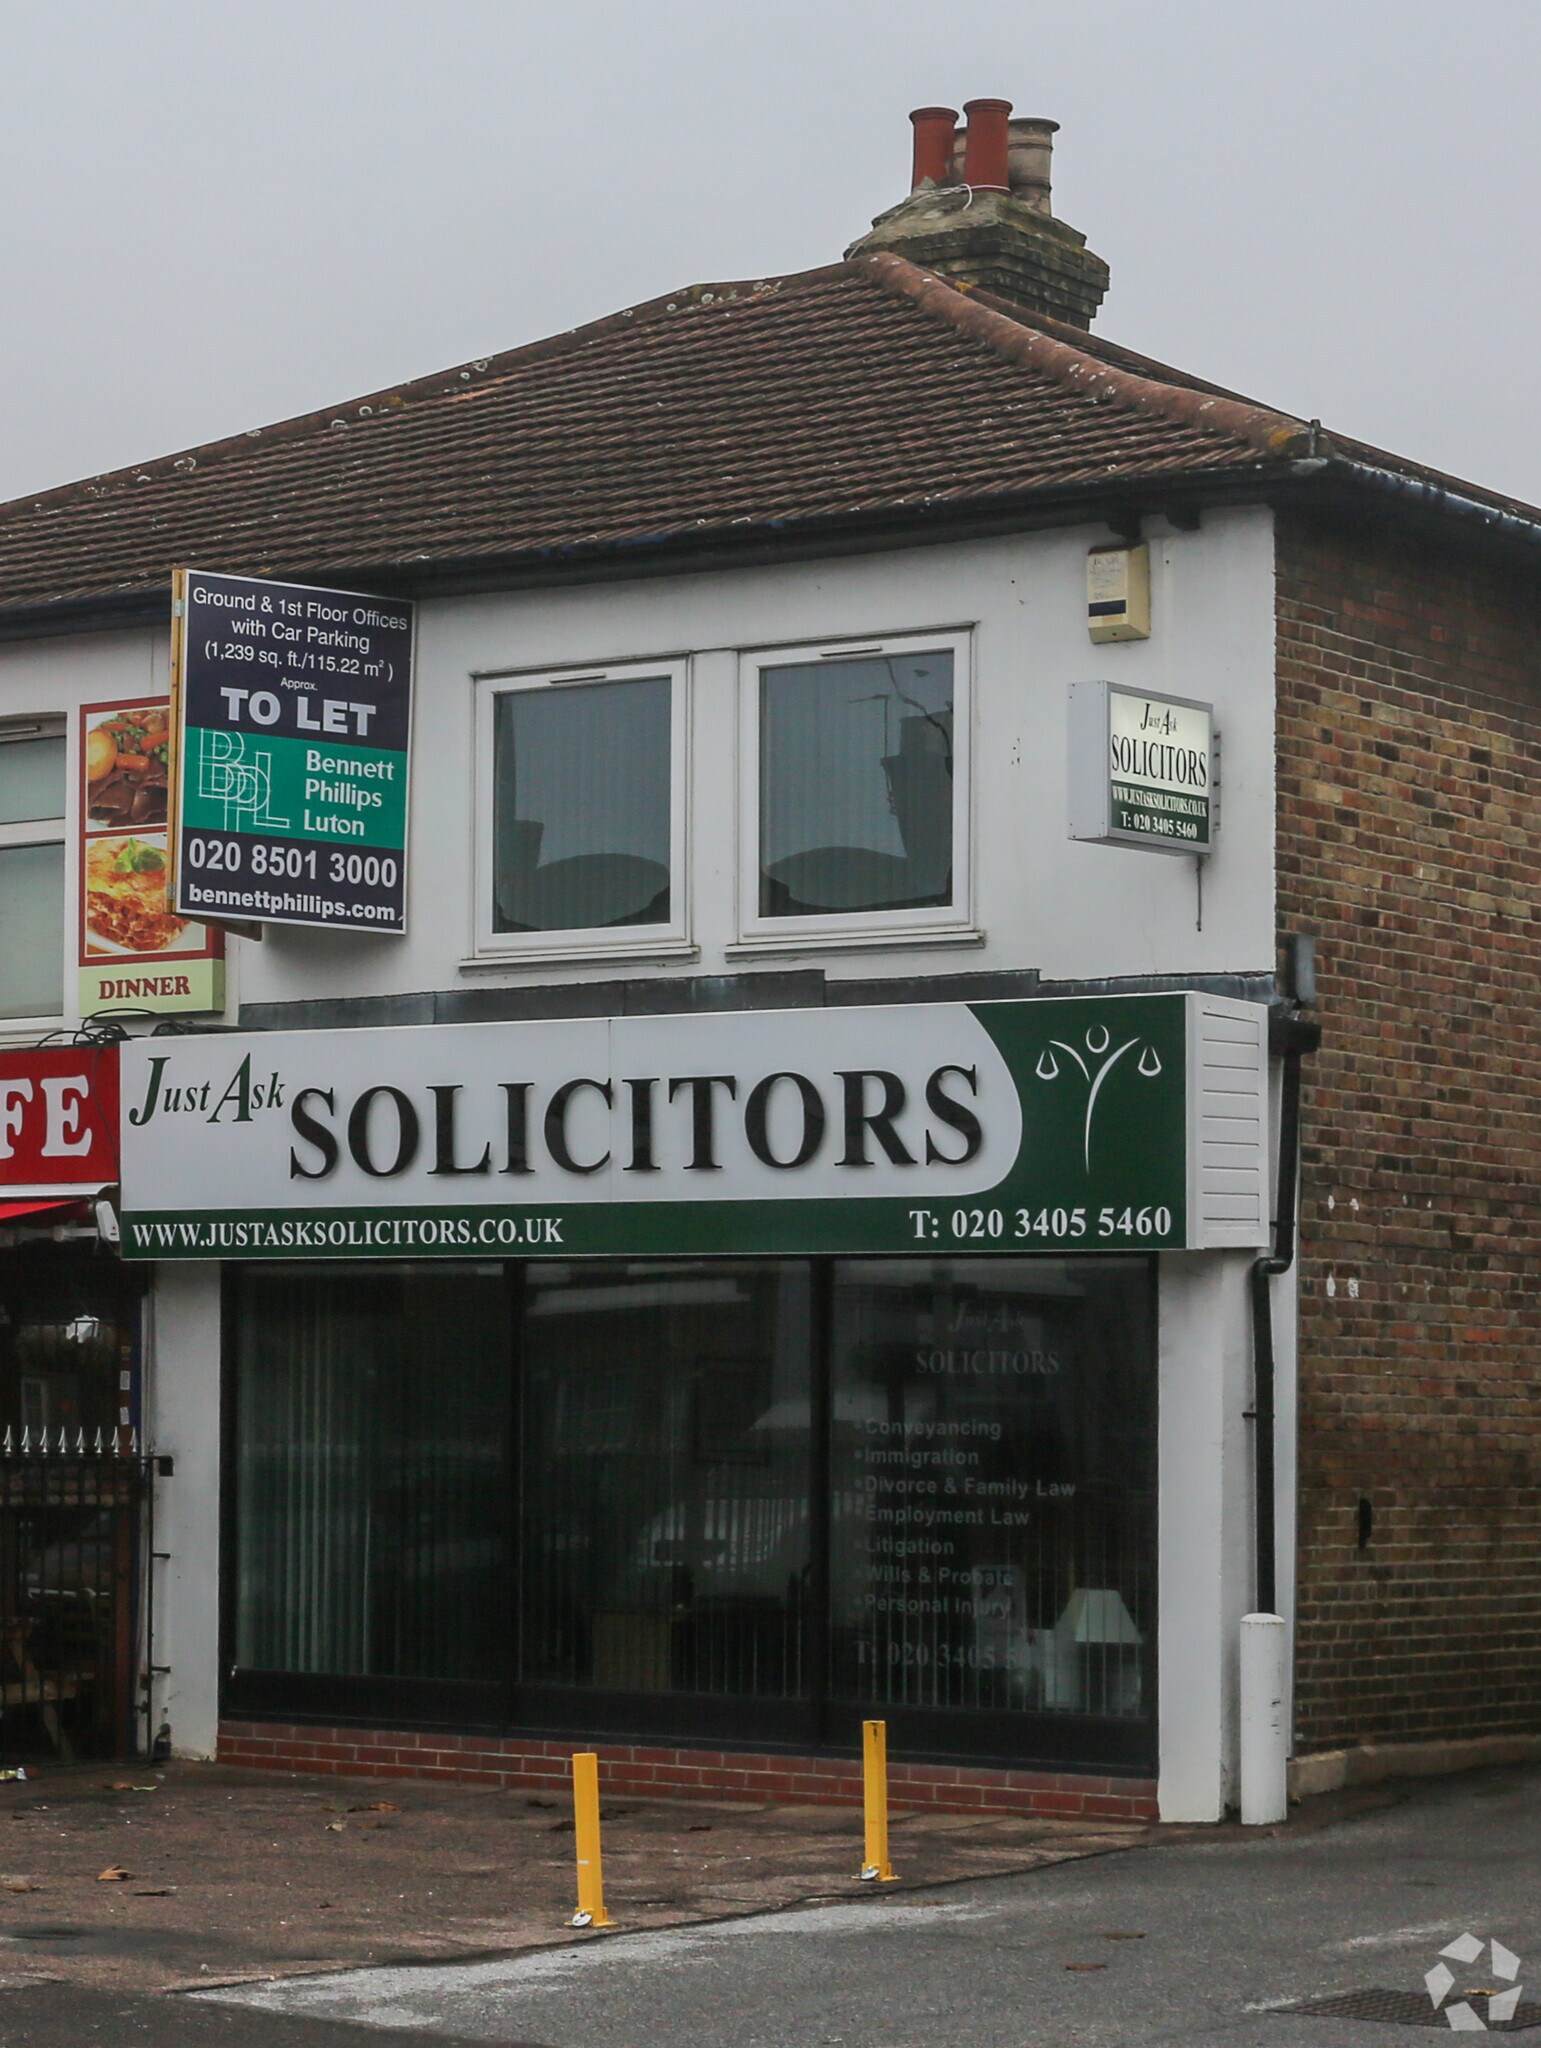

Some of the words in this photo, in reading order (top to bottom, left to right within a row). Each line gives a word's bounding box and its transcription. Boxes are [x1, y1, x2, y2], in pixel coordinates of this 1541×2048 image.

[193, 587, 256, 611] Ground
[260, 596, 273, 613] &
[279, 600, 302, 618] 1st
[307, 602, 348, 623] Floor
[353, 608, 407, 631] Offices
[232, 619, 266, 638] with
[272, 622, 301, 641] Car
[307, 627, 370, 654] Parking
[204, 640, 254, 663] (1,239
[259, 650, 283, 668] sq.
[287, 650, 360, 676] ft./115.22
[280, 676, 318, 693] Approx.
[220, 686, 281, 726] TO
[296, 696, 376, 737] LET
[1140, 702, 1161, 731] Just
[1159, 708, 1178, 736] Ask
[306, 749, 394, 782] Bennett
[1112, 734, 1207, 788] SOLICITORS
[304, 778, 383, 809] Phillips
[303, 809, 365, 837] Luton
[1121, 811, 1132, 828] T:
[1133, 813, 1151, 832] 020
[1152, 816, 1174, 835] 3405
[1176, 820, 1198, 839] 5460
[189, 838, 242, 873] 020
[251, 844, 317, 880] 8501
[329, 853, 397, 889] 3000
[189, 883, 396, 921] bennettphillips.com
[98, 975, 190, 1001] DINNER
[128, 1056, 211, 1127] Just
[207, 1052, 286, 1125] Ask
[289, 1063, 984, 1181] SOLICITORS
[132, 1217, 564, 1248] WWW.JUSTASKSOLICITORS.CO.UK
[909, 1210, 940, 1239] T:
[951, 1209, 1003, 1238] 020
[1014, 1207, 1086, 1238] 3405
[1098, 1206, 1172, 1237] 5460
[915, 1350, 1061, 1375] SOLICITORS
[865, 1418, 1002, 1440] Conveyancing
[865, 1448, 979, 1469] Immigration
[865, 1476, 937, 1495] Divorce
[944, 1477, 958, 1495] &
[964, 1480, 1028, 1501] Family
[1036, 1481, 1077, 1498] Law
[866, 1507, 984, 1528] Employment
[991, 1509, 1030, 1527] Law
[866, 1536, 954, 1557] Litigation
[866, 1566, 910, 1584] Wills
[918, 1567, 932, 1584] &
[939, 1567, 1014, 1586] Probate
[865, 1595, 950, 1614] Personal
[955, 1597, 1011, 1619] Injury
[888, 1640, 928, 1666] 020
[938, 1642, 996, 1670] 3405
